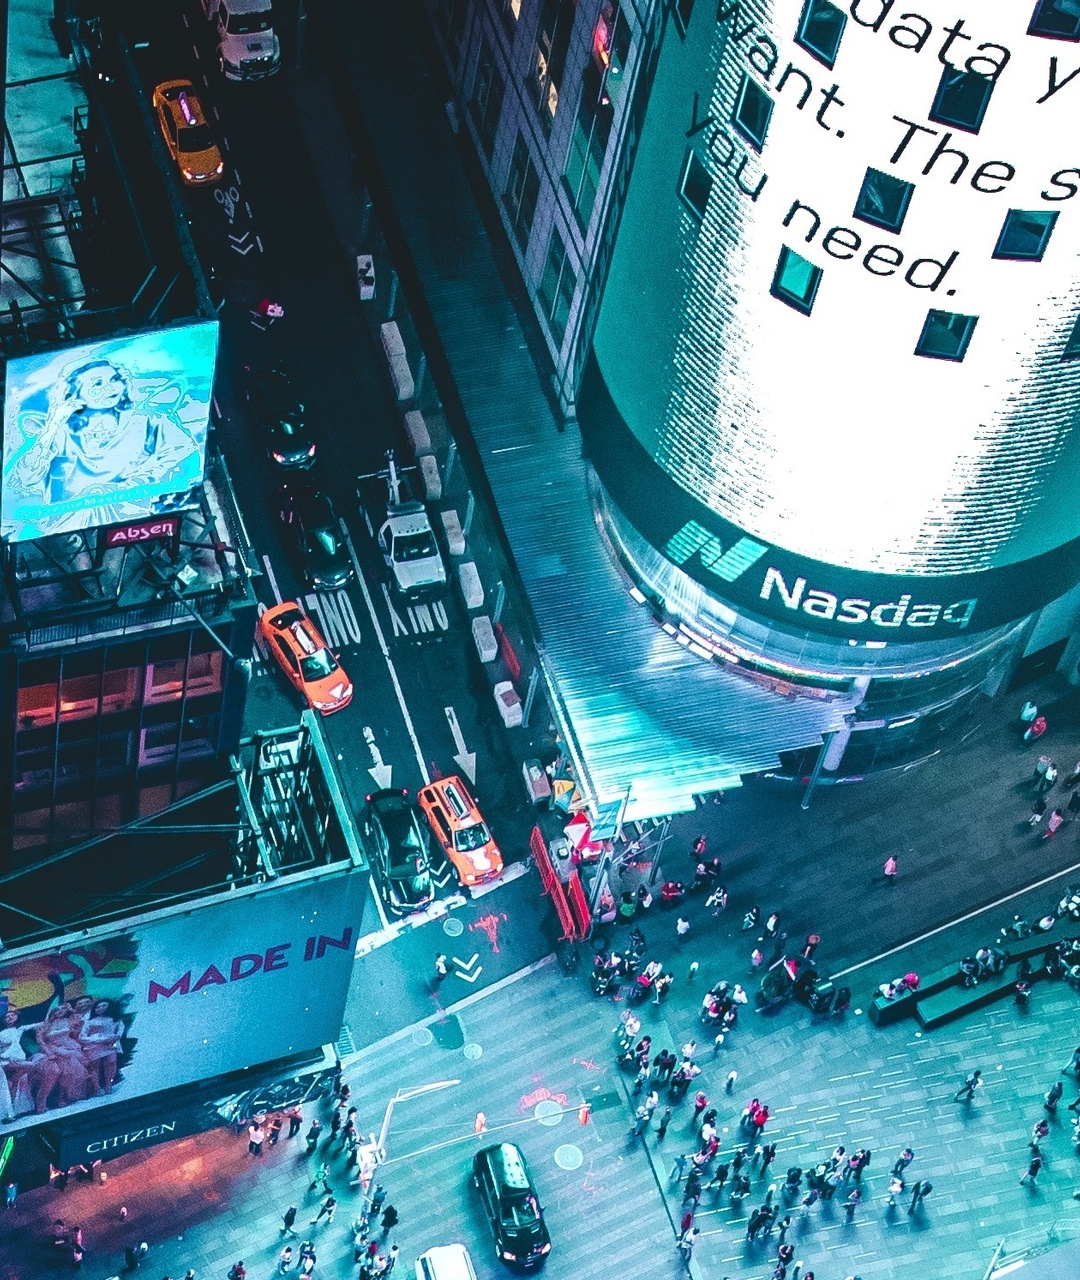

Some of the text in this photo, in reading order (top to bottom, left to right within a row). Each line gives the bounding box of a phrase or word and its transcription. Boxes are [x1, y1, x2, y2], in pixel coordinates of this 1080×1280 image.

[889, 115, 1016, 193] The
[685, 90, 960, 296] you need.
[110, 522, 174, 544] Absen
[296, 589, 361, 649] ONL
[759, 566, 978, 629] Nasdaq
[147, 927, 353, 1003] MADE IN
[86, 1121, 177, 1154] CITIZEN
